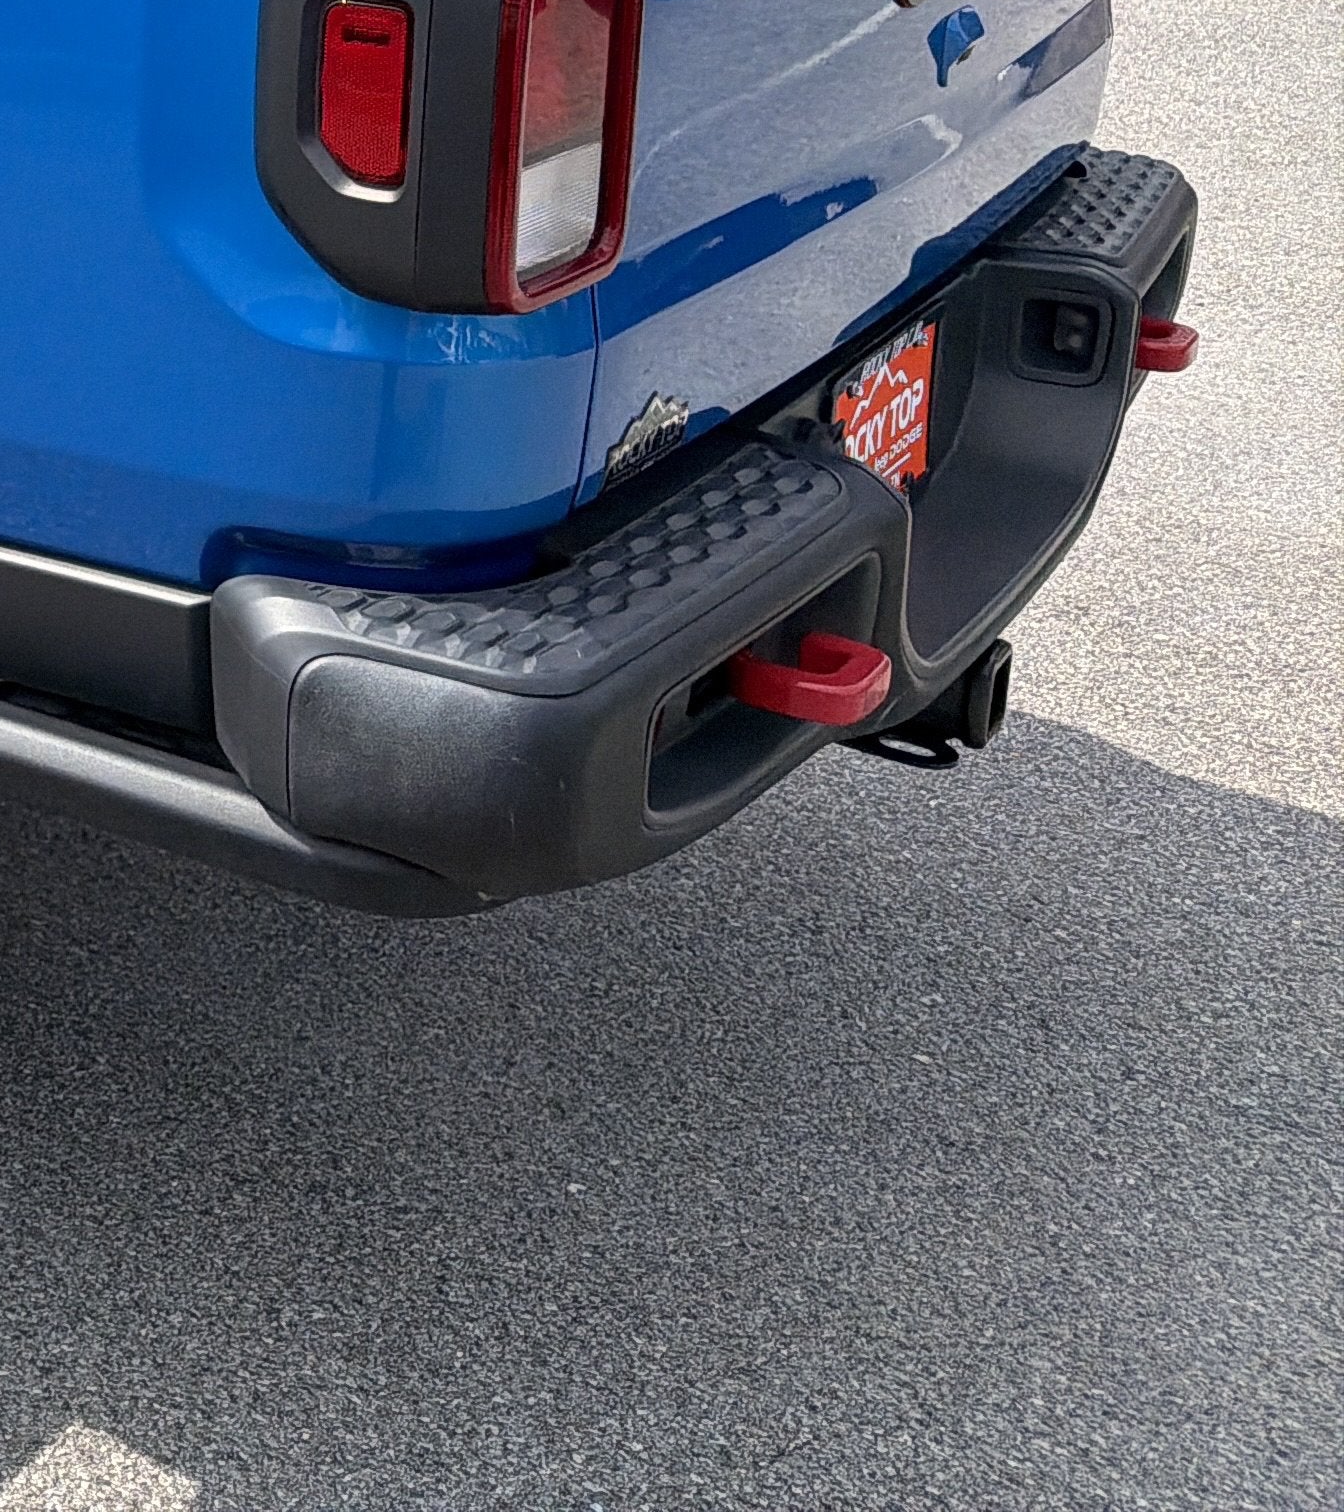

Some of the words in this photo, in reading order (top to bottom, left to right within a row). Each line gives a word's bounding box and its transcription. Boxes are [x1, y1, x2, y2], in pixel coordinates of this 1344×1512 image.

[845, 405, 889, 464] OCKY
[890, 377, 924, 438] TOP
[890, 421, 924, 460] DODGE
